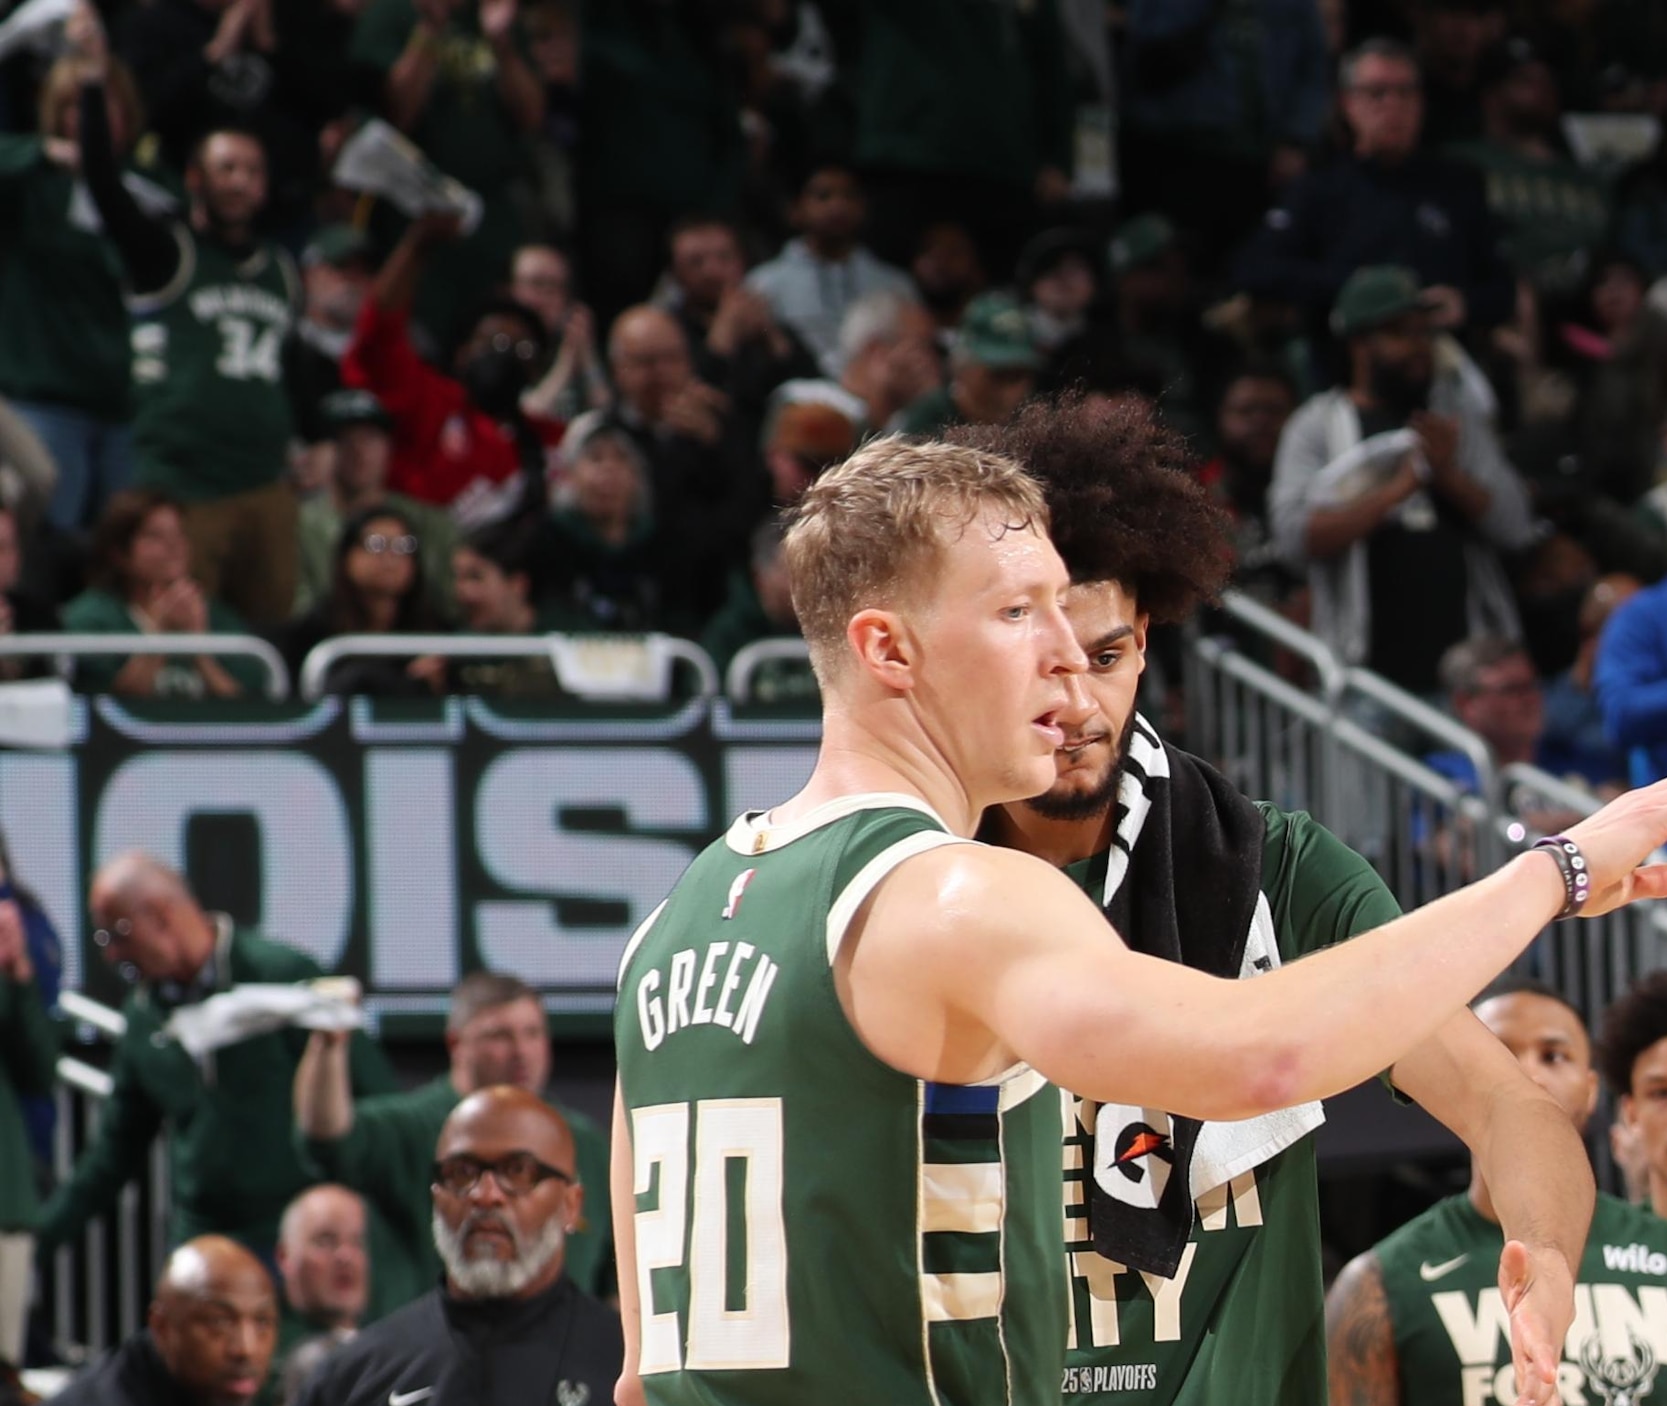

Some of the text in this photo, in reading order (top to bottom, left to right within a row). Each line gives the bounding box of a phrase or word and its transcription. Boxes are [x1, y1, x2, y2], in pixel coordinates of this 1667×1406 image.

[637, 941, 779, 1052] GREEN
[631, 1096, 791, 1376] 20
[1061, 1363, 1157, 1393] 25 PLAYOFFS
